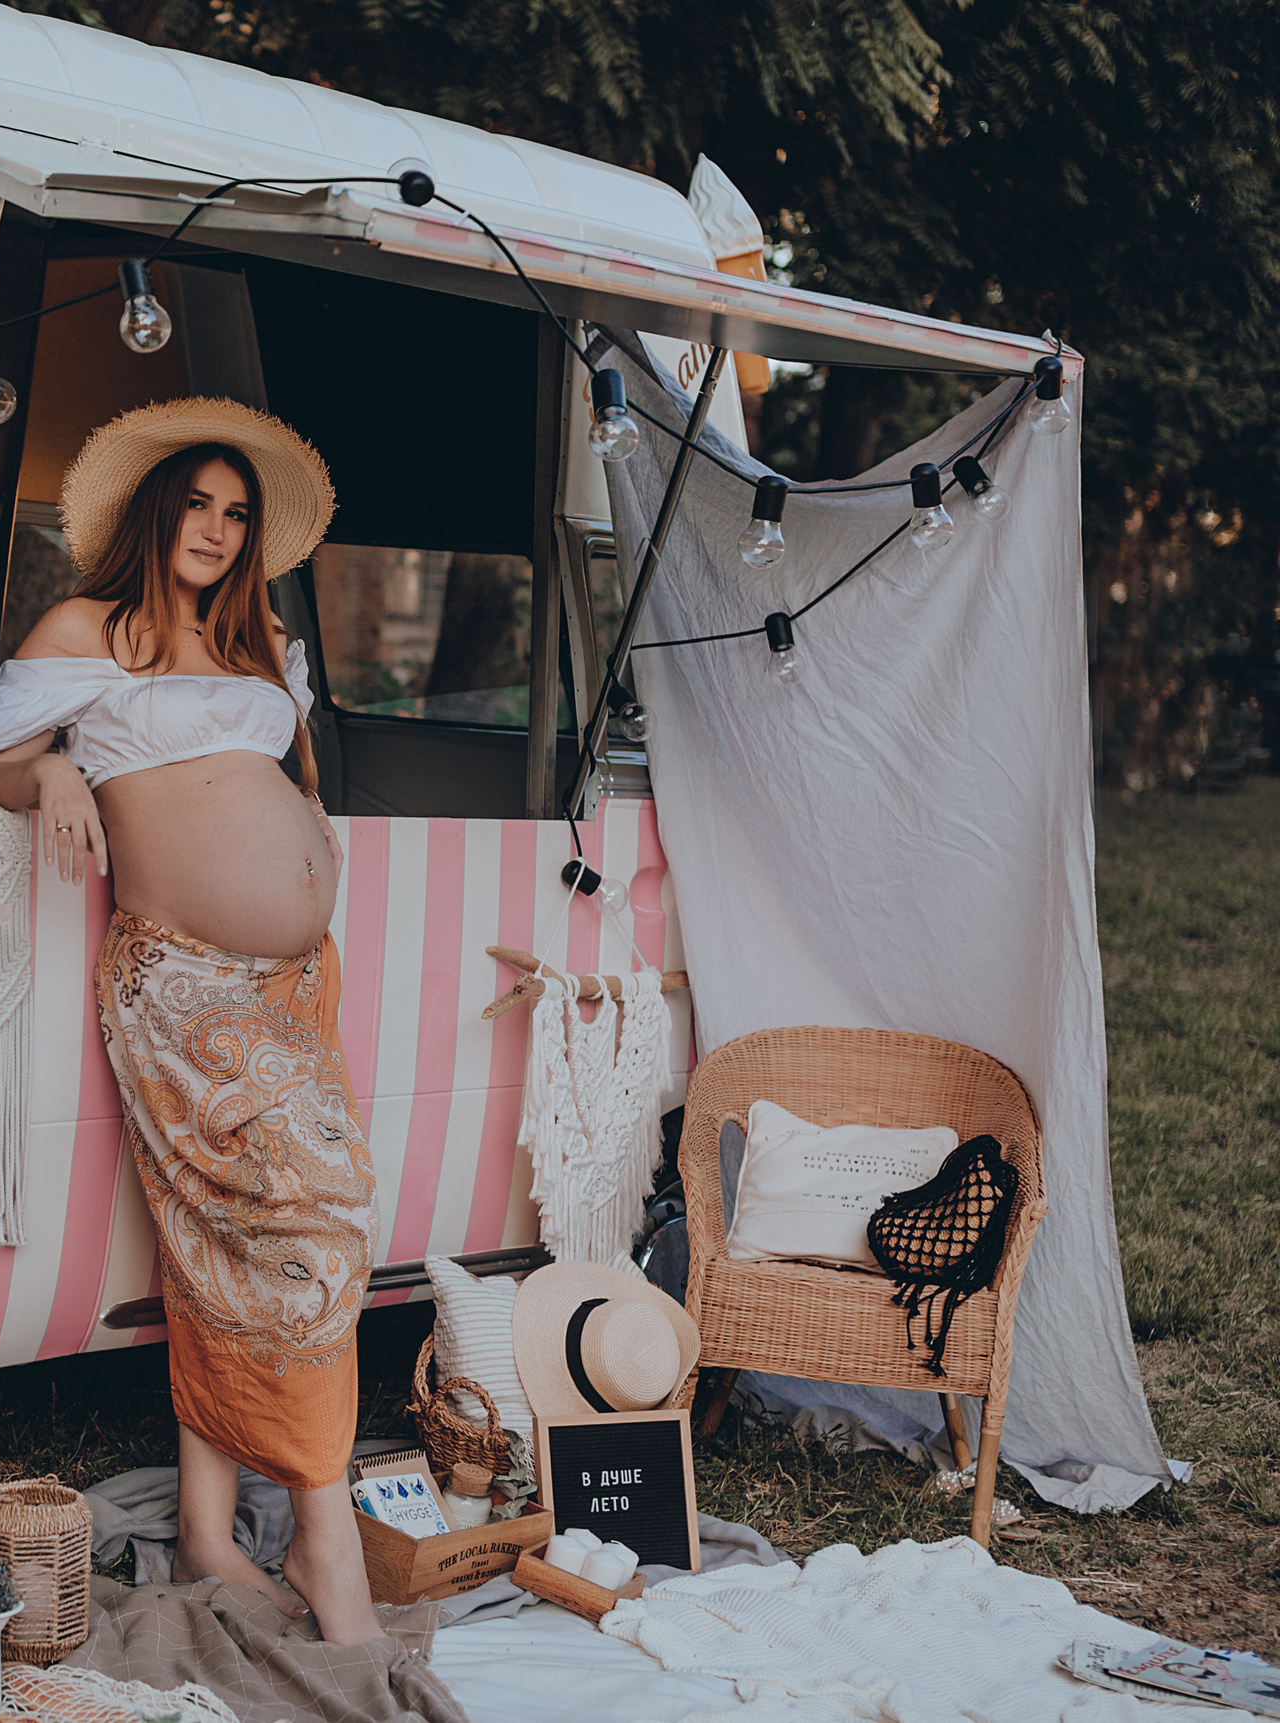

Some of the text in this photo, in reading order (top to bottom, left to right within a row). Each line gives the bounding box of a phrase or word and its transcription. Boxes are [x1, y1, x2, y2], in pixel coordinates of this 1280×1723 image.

[582, 1469, 643, 1487] В ДУШЕ
[590, 1496, 630, 1513] ЛЕТО
[394, 1507, 433, 1522] HYGGE
[438, 1553, 458, 1573] THE
[459, 1543, 488, 1562] LOCAL
[451, 1573, 474, 1585] GRAINS
[474, 1569, 481, 1580] &
[1117, 1646, 1188, 1675] Esquire
